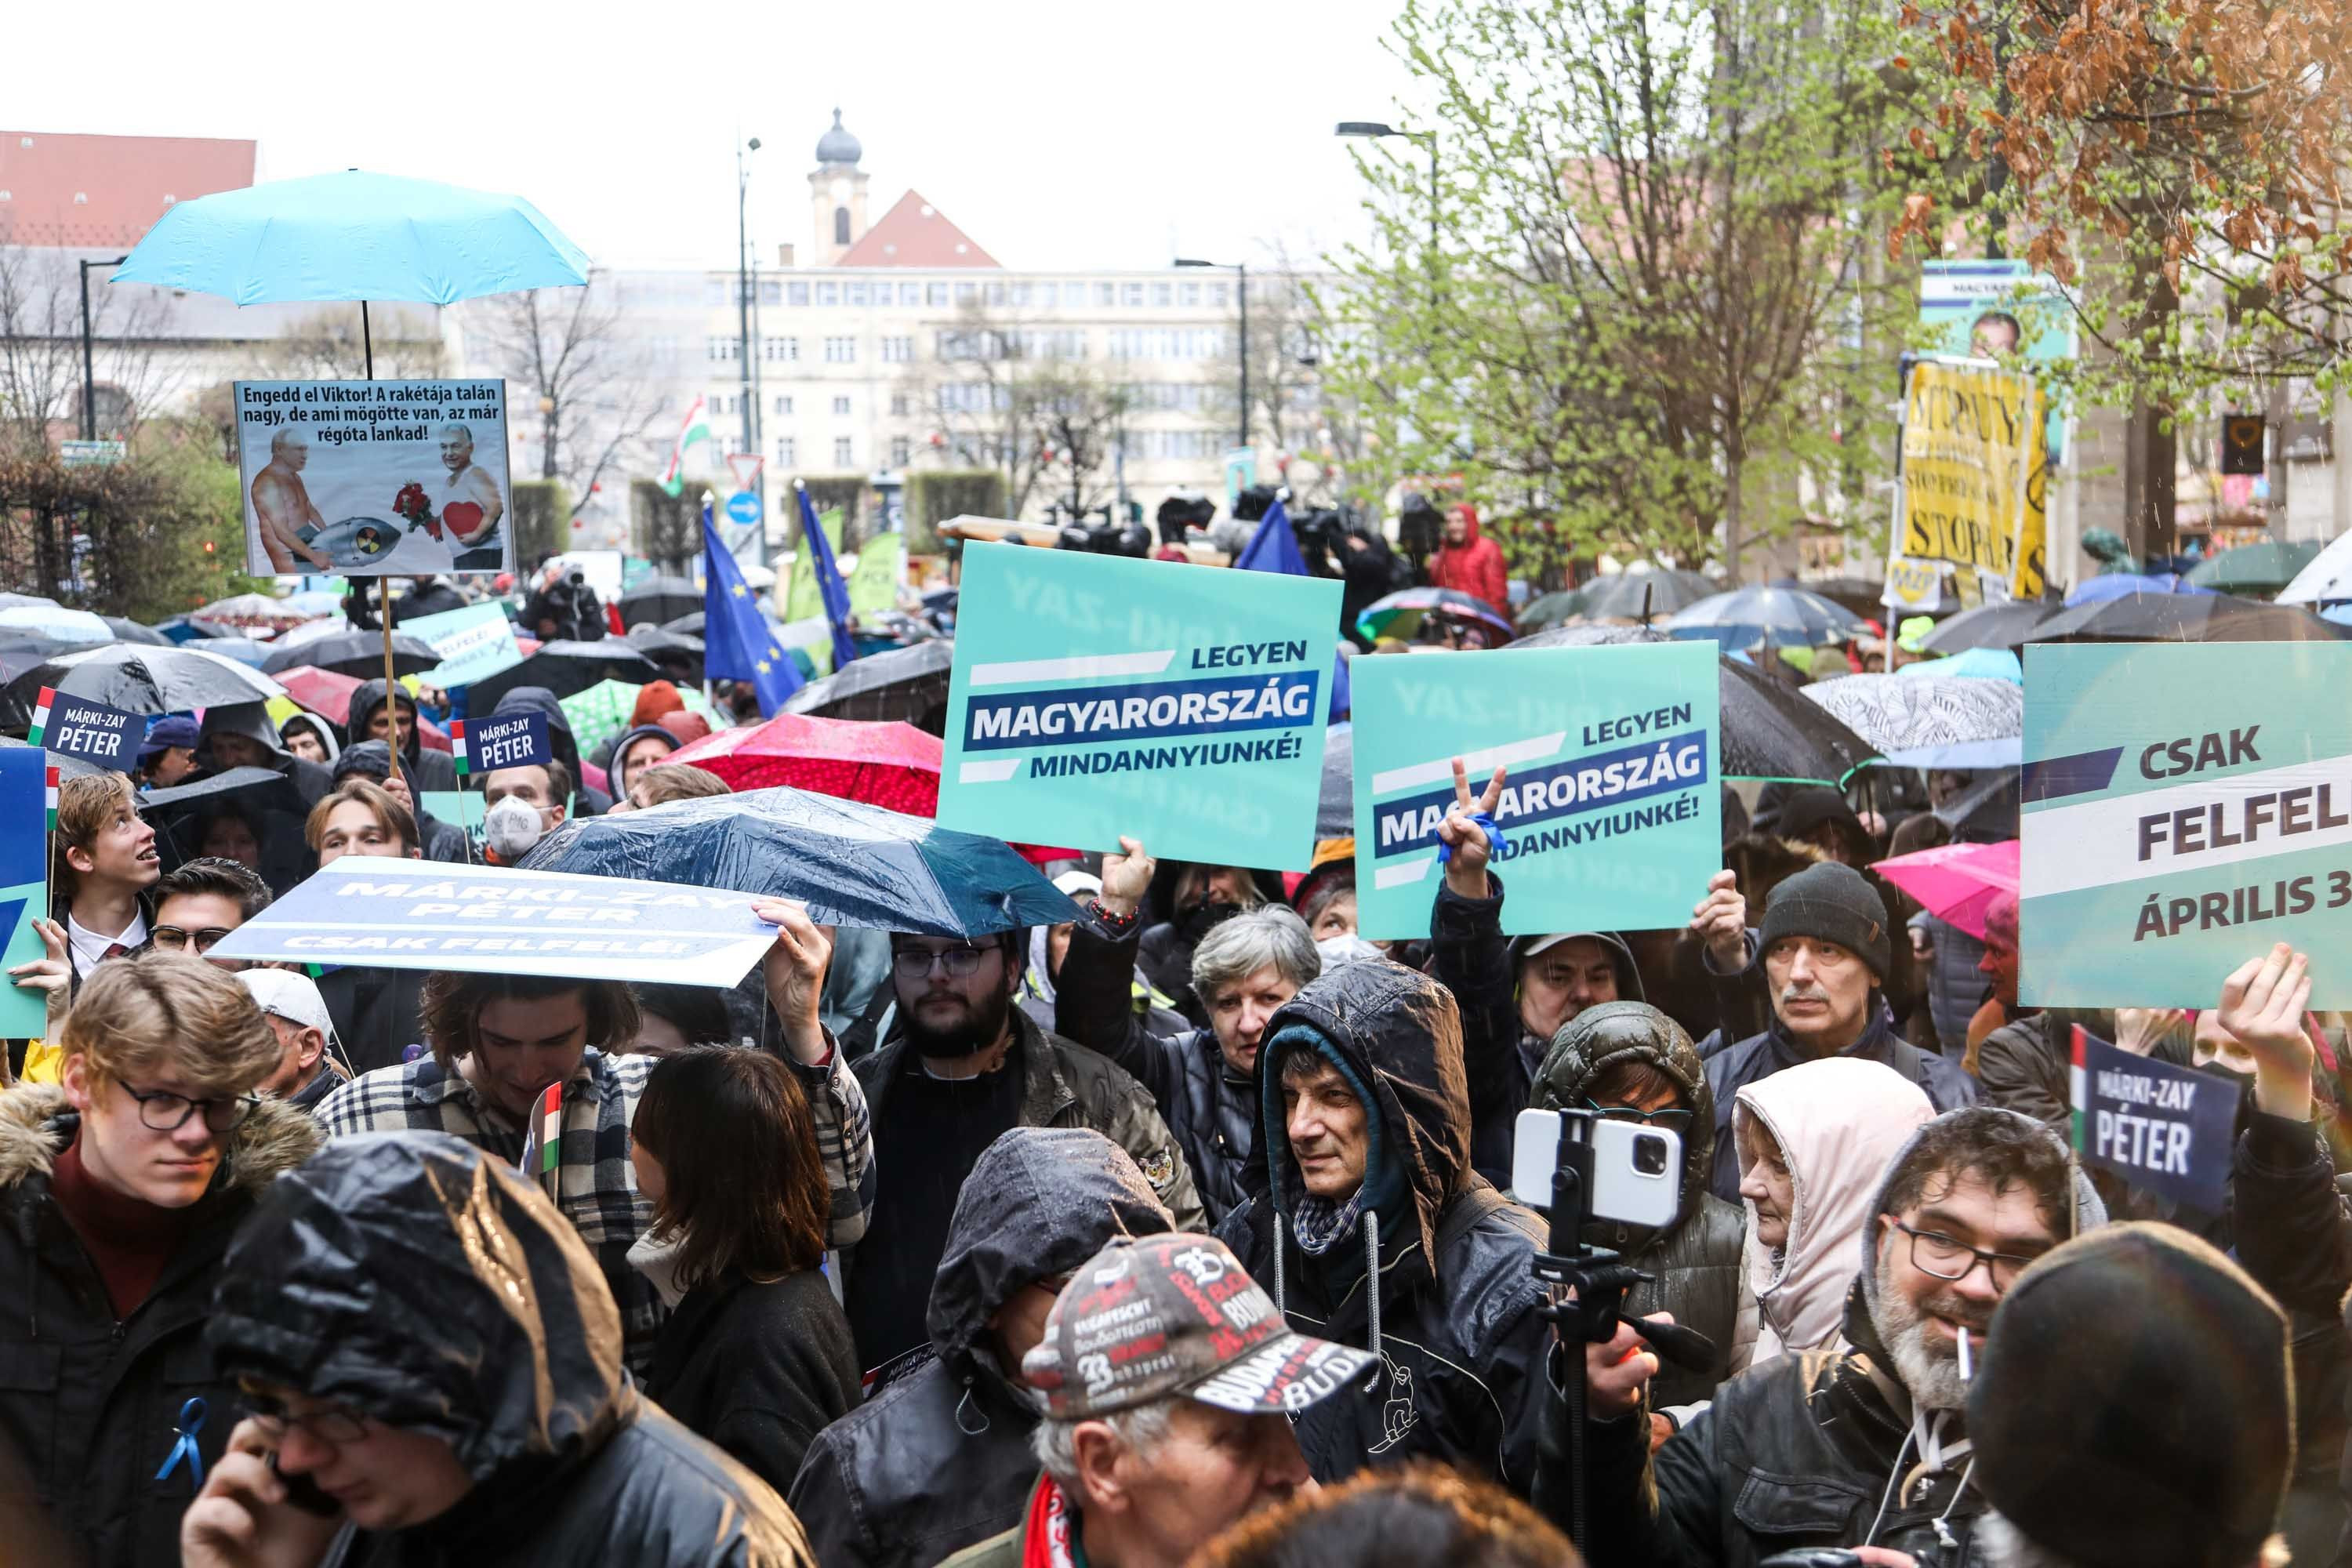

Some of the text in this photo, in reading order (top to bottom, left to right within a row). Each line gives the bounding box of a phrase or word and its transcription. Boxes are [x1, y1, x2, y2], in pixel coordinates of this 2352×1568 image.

[244, 384, 495, 406] Engedd el Viktor! A rakétája talán
[244, 405, 499, 426] nagy, de ami mögötte van, az már
[318, 426, 429, 445] régóta lankad!
[1192, 640, 1307, 670] LEGYEN
[65, 707, 127, 728] MÁRKI-ZAY
[972, 677, 1309, 740] MAGYARORSZÁG
[1583, 702, 1691, 746] LEGYEN
[56, 724, 122, 757] PÉTER
[479, 717, 529, 743] MÁRKI-ZAY
[481, 735, 534, 768] PÉTER
[1029, 732, 1302, 779] MINDANNYIUNKÉ!
[2139, 725, 2262, 780] CSAK
[1381, 742, 1700, 847] MAARORSZÁG
[2138, 782, 2352, 862] FELFEL
[336, 881, 752, 909] MÁRKI-ZAY
[2133, 873, 2315, 942] ÁPRILIS
[407, 901, 641, 923] PÉTER
[282, 936, 439, 949] CSAK
[2096, 1066, 2197, 1111] MÁRKI-ZAY
[2096, 1102, 2191, 1175] PÉTER
